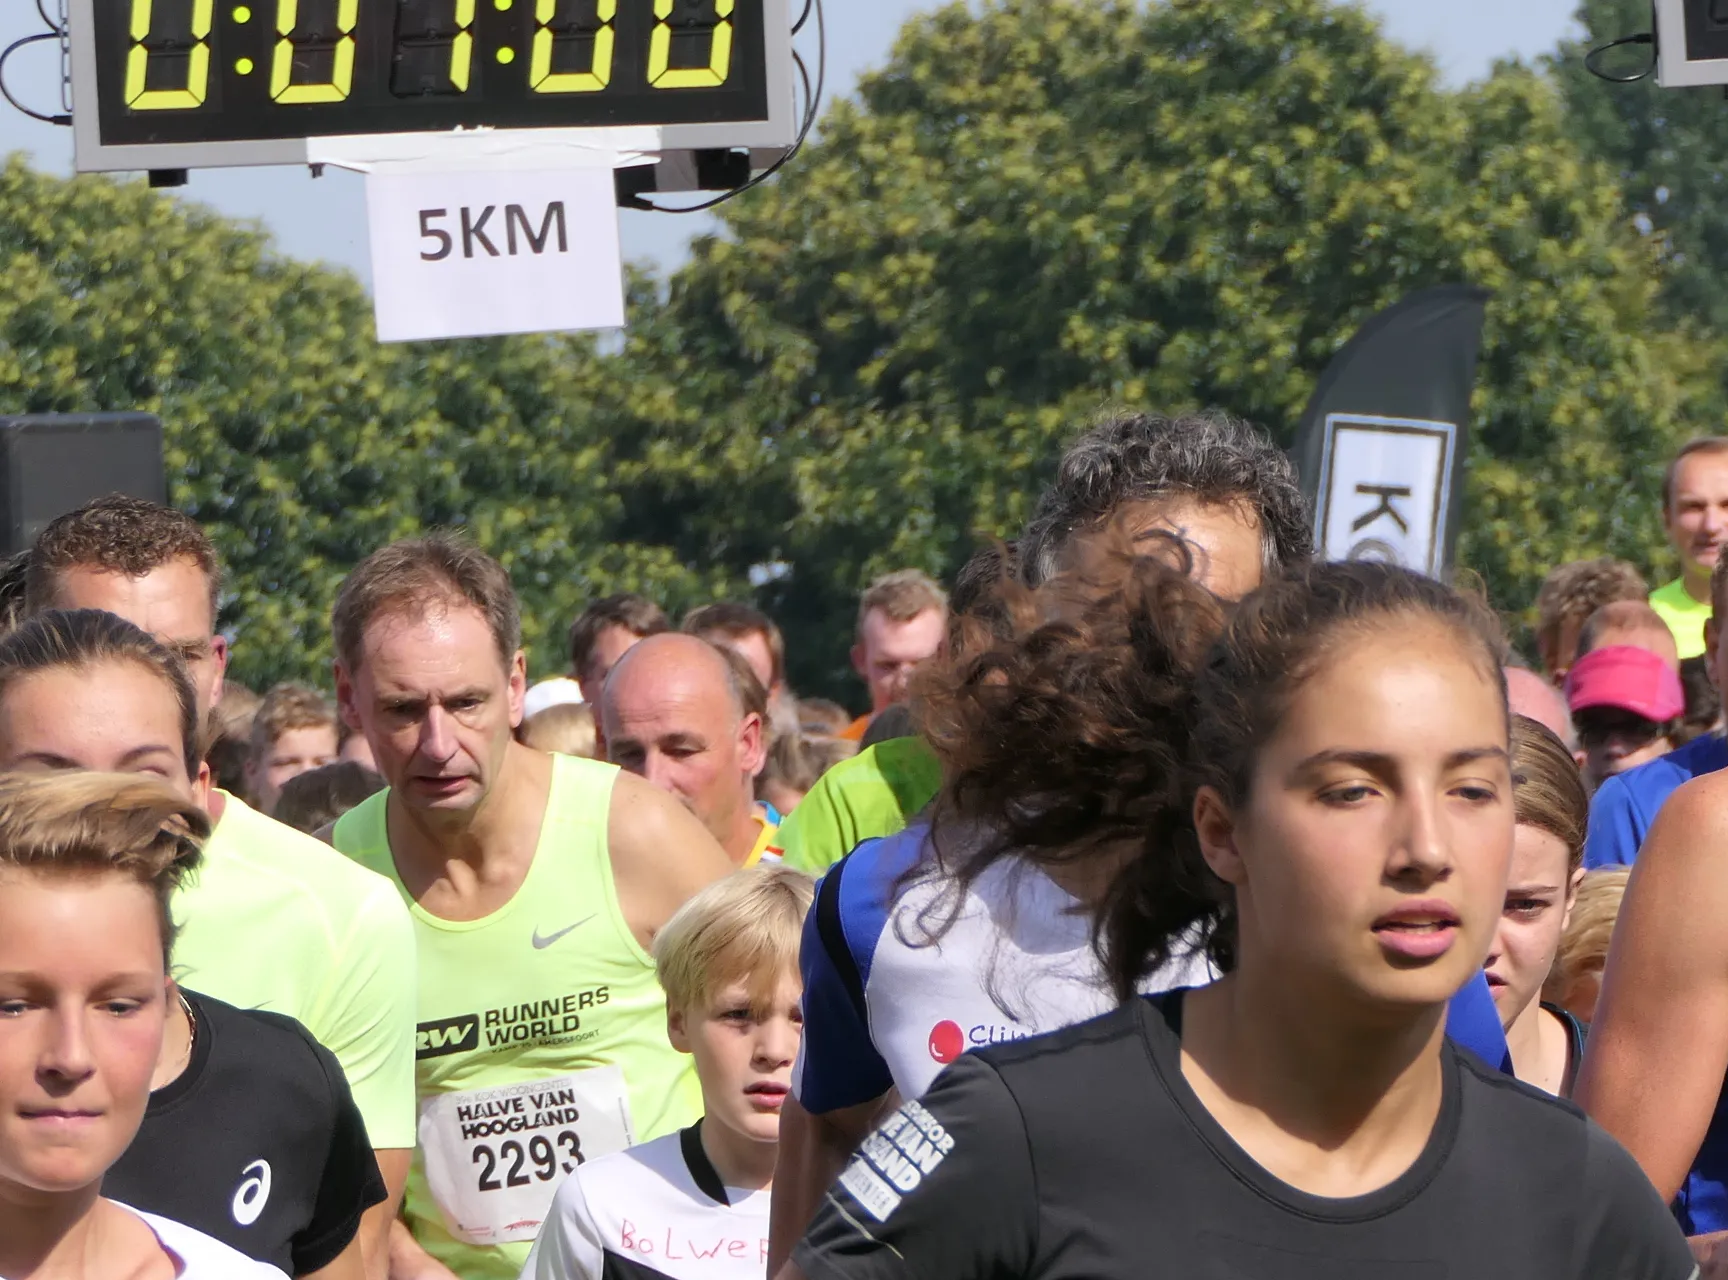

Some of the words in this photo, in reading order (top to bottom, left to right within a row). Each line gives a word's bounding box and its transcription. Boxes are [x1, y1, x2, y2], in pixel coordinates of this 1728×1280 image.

[418, 200, 569, 262] 5KM
[485, 986, 610, 1028] RUNNERS
[485, 1015, 580, 1047] WORLD
[457, 1097, 524, 1122] HALVE
[529, 1088, 576, 1110] VAN
[461, 1107, 580, 1140] HOOGLAND
[472, 1130, 586, 1192] 2293
